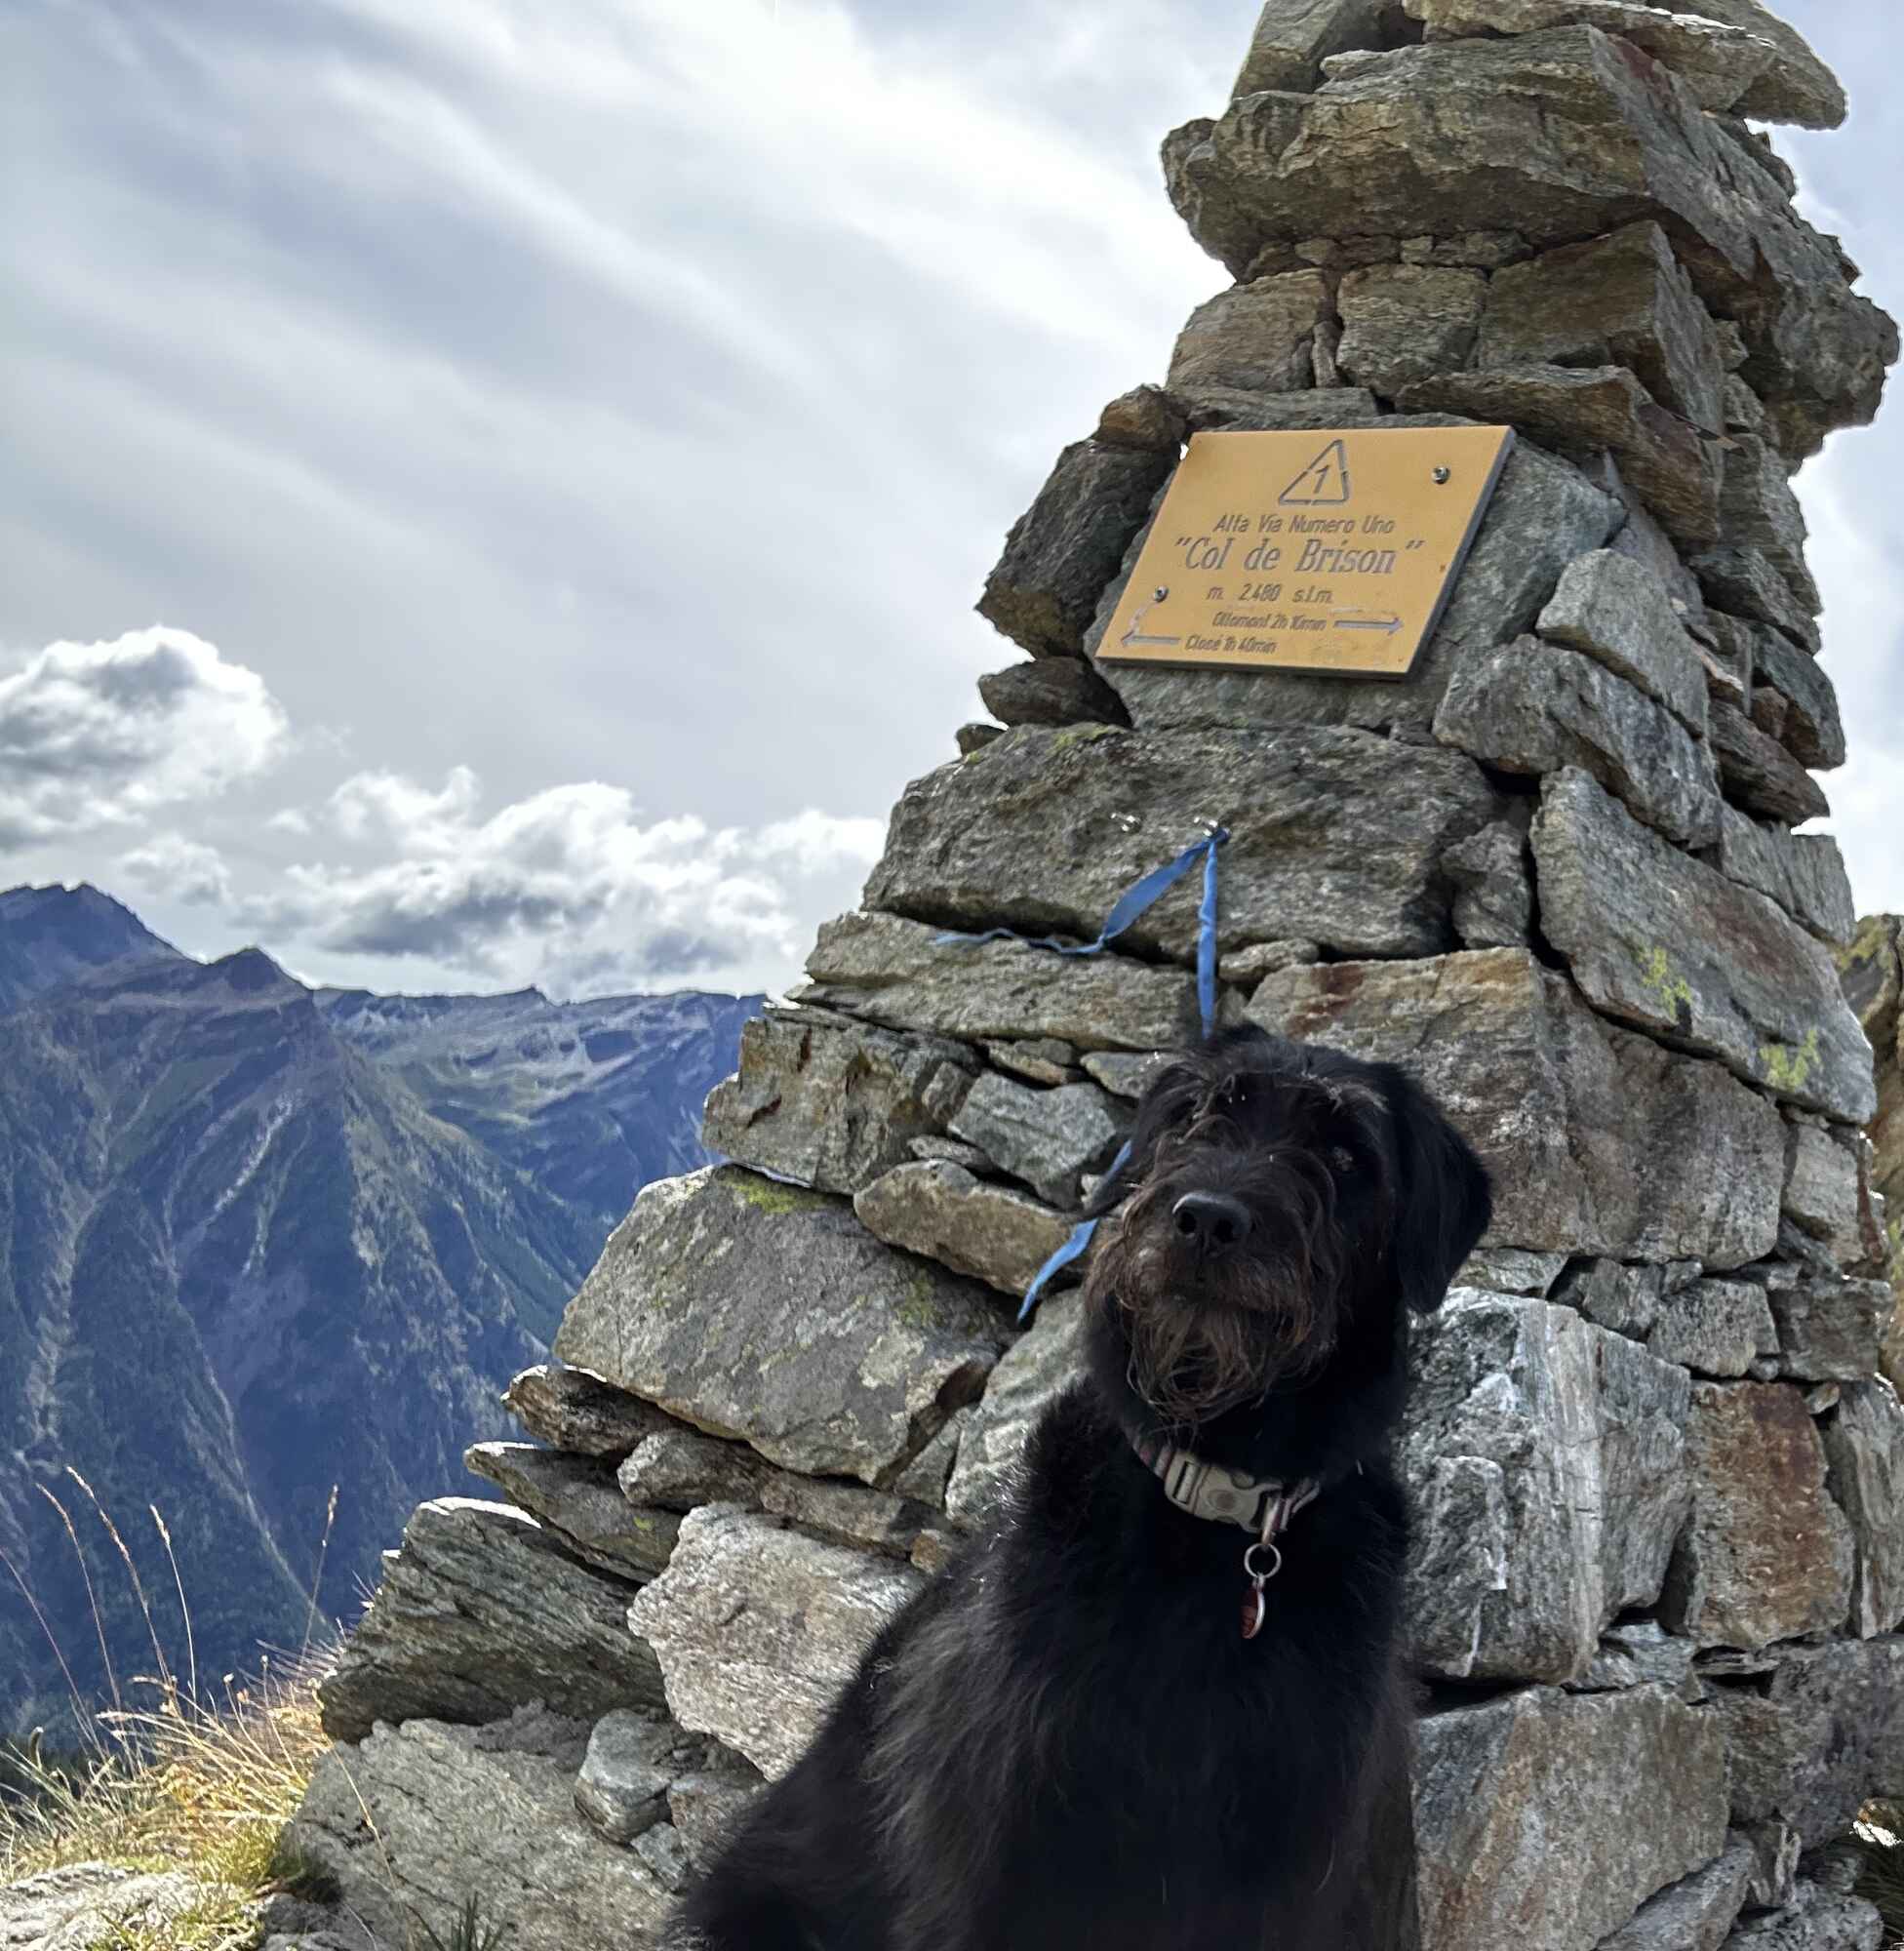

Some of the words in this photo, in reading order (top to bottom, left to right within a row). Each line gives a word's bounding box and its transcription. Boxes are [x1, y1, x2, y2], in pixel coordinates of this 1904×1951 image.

[1313, 464, 1330, 494] 1
[1212, 514, 1250, 533] Alta
[1259, 514, 1283, 533] Via
[1289, 514, 1355, 534] Numero
[1363, 515, 1395, 534] Uno
[1244, 538, 1282, 572] de
[1270, 613, 1288, 629] 2h
[1237, 638, 1278, 655] 40min
